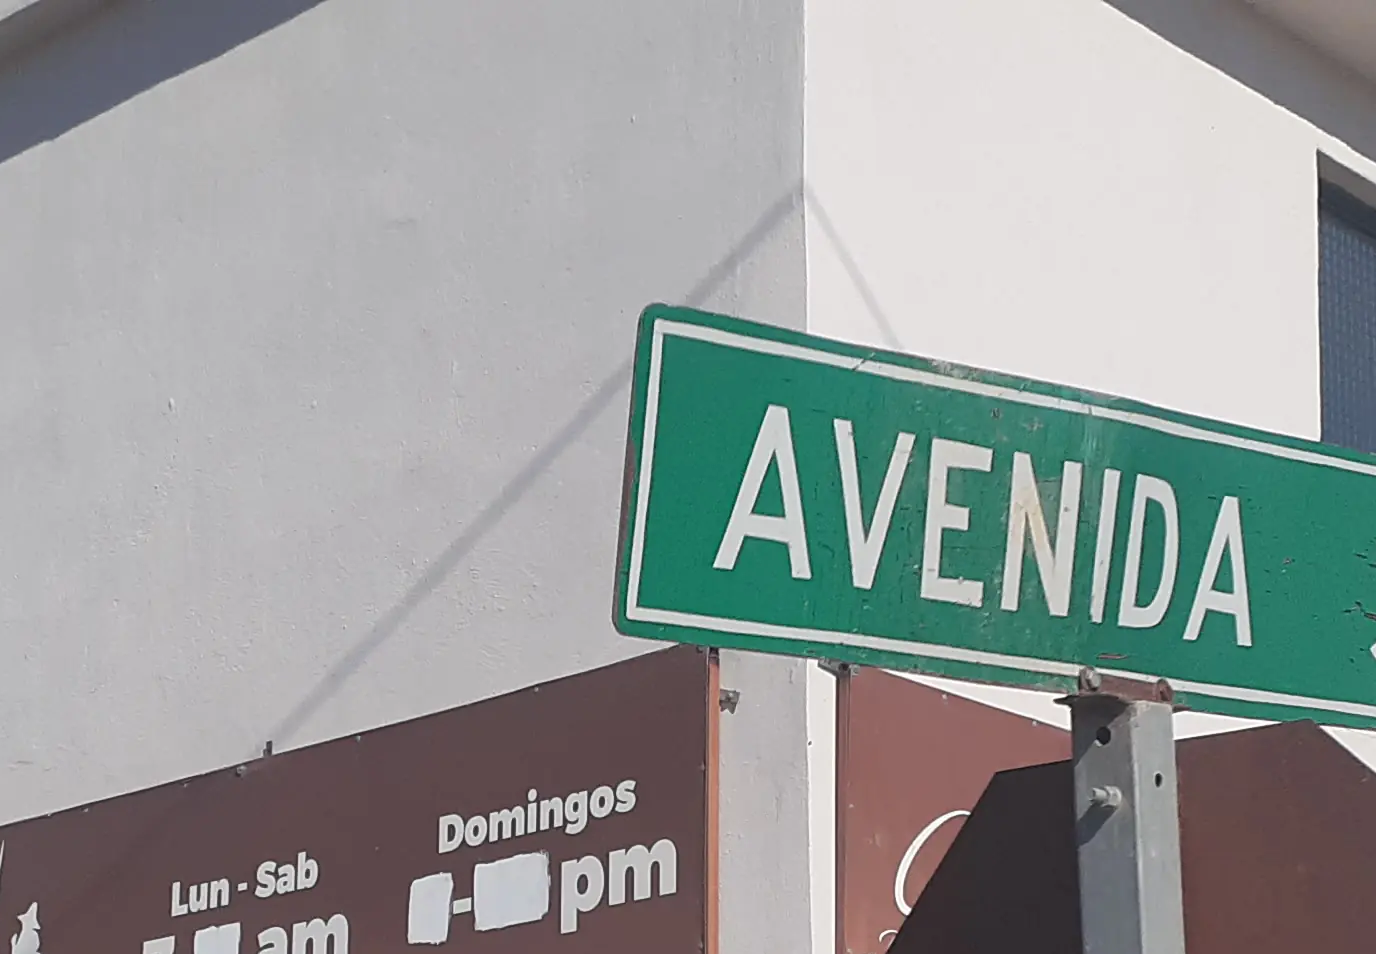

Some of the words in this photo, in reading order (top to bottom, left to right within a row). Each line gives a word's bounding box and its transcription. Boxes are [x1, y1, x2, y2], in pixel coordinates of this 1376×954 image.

[713, 405, 1252, 647] AVENIDA
[438, 777, 637, 853] Domingos
[171, 879, 230, 917] Lun
[254, 851, 319, 898] Sab
[560, 838, 678, 935] pm
